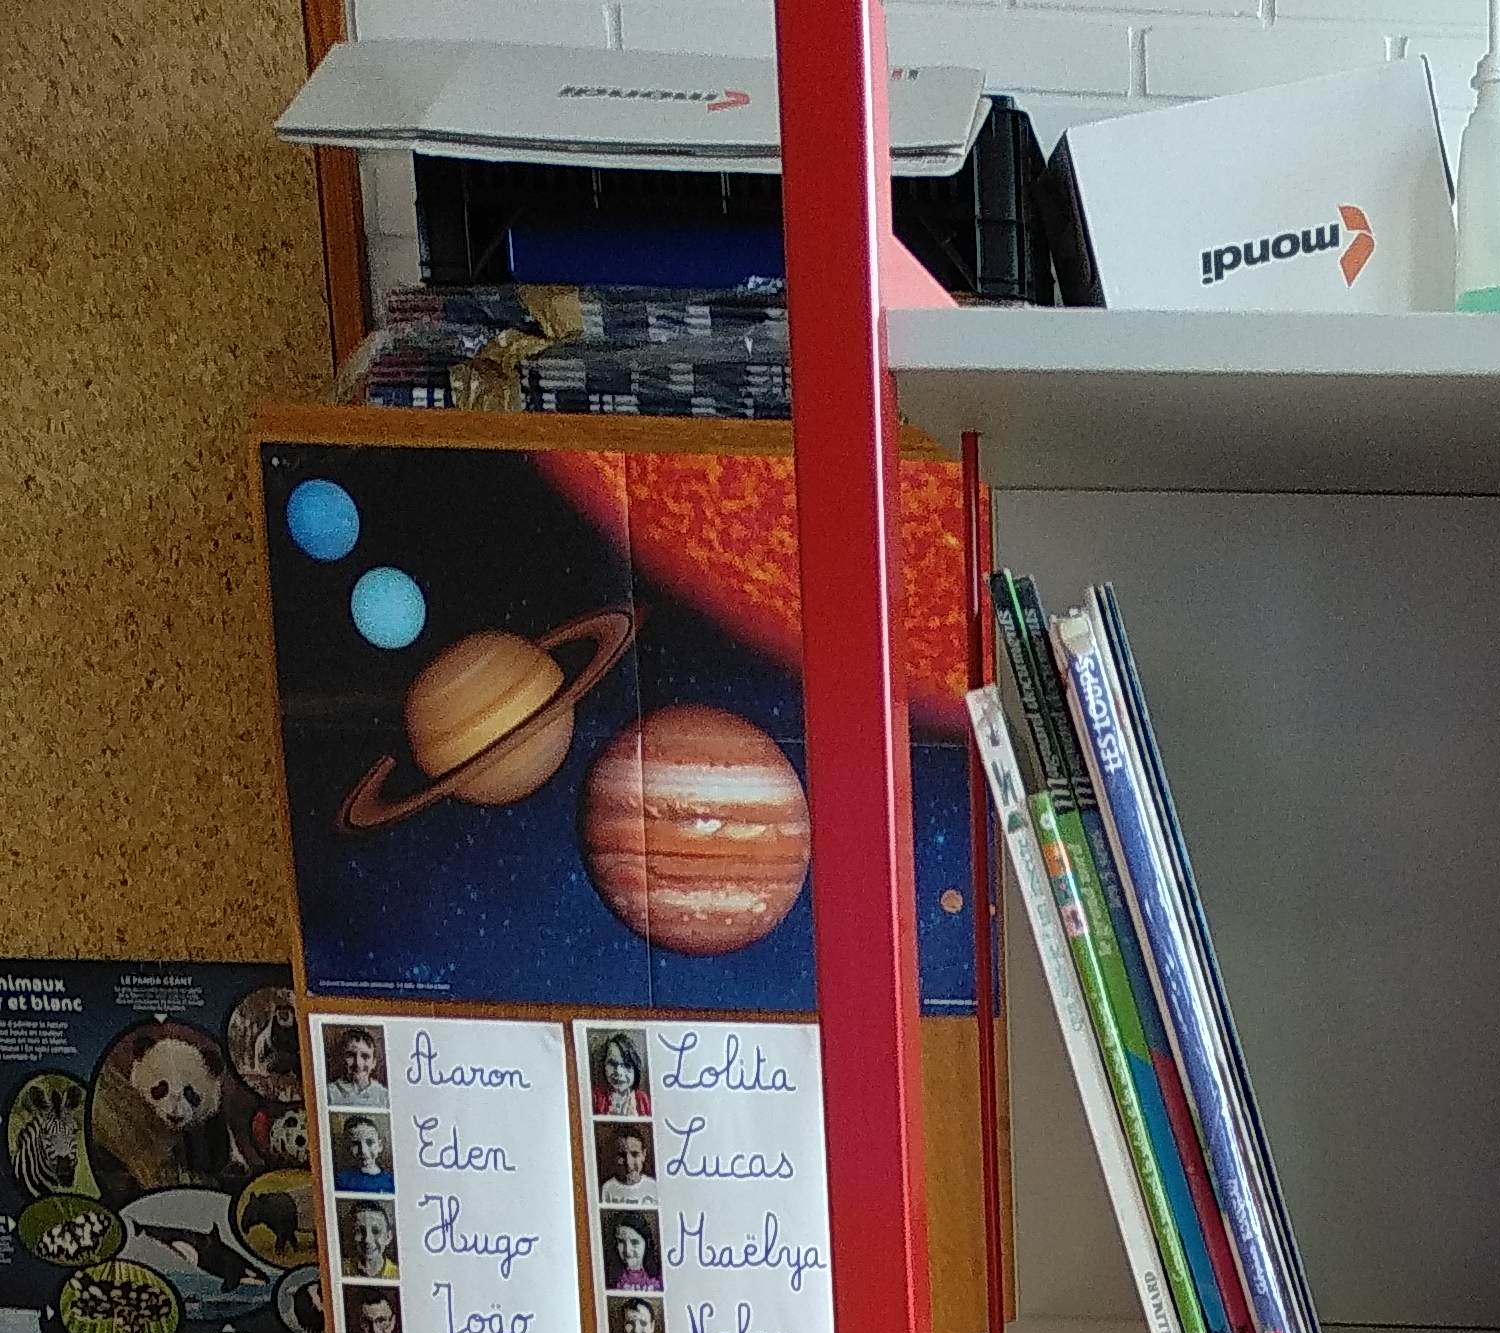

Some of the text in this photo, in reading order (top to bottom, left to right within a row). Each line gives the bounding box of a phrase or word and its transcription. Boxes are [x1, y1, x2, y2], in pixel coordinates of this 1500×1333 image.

[1200, 222, 1341, 285] mondi
[30, 994, 83, 1012] blanc
[407, 1031, 531, 1089] Aaron
[659, 1032, 797, 1092] Lolita
[413, 1116, 516, 1171] Eden
[665, 1117, 795, 1178] Lucas
[418, 1195, 539, 1278] Hugo
